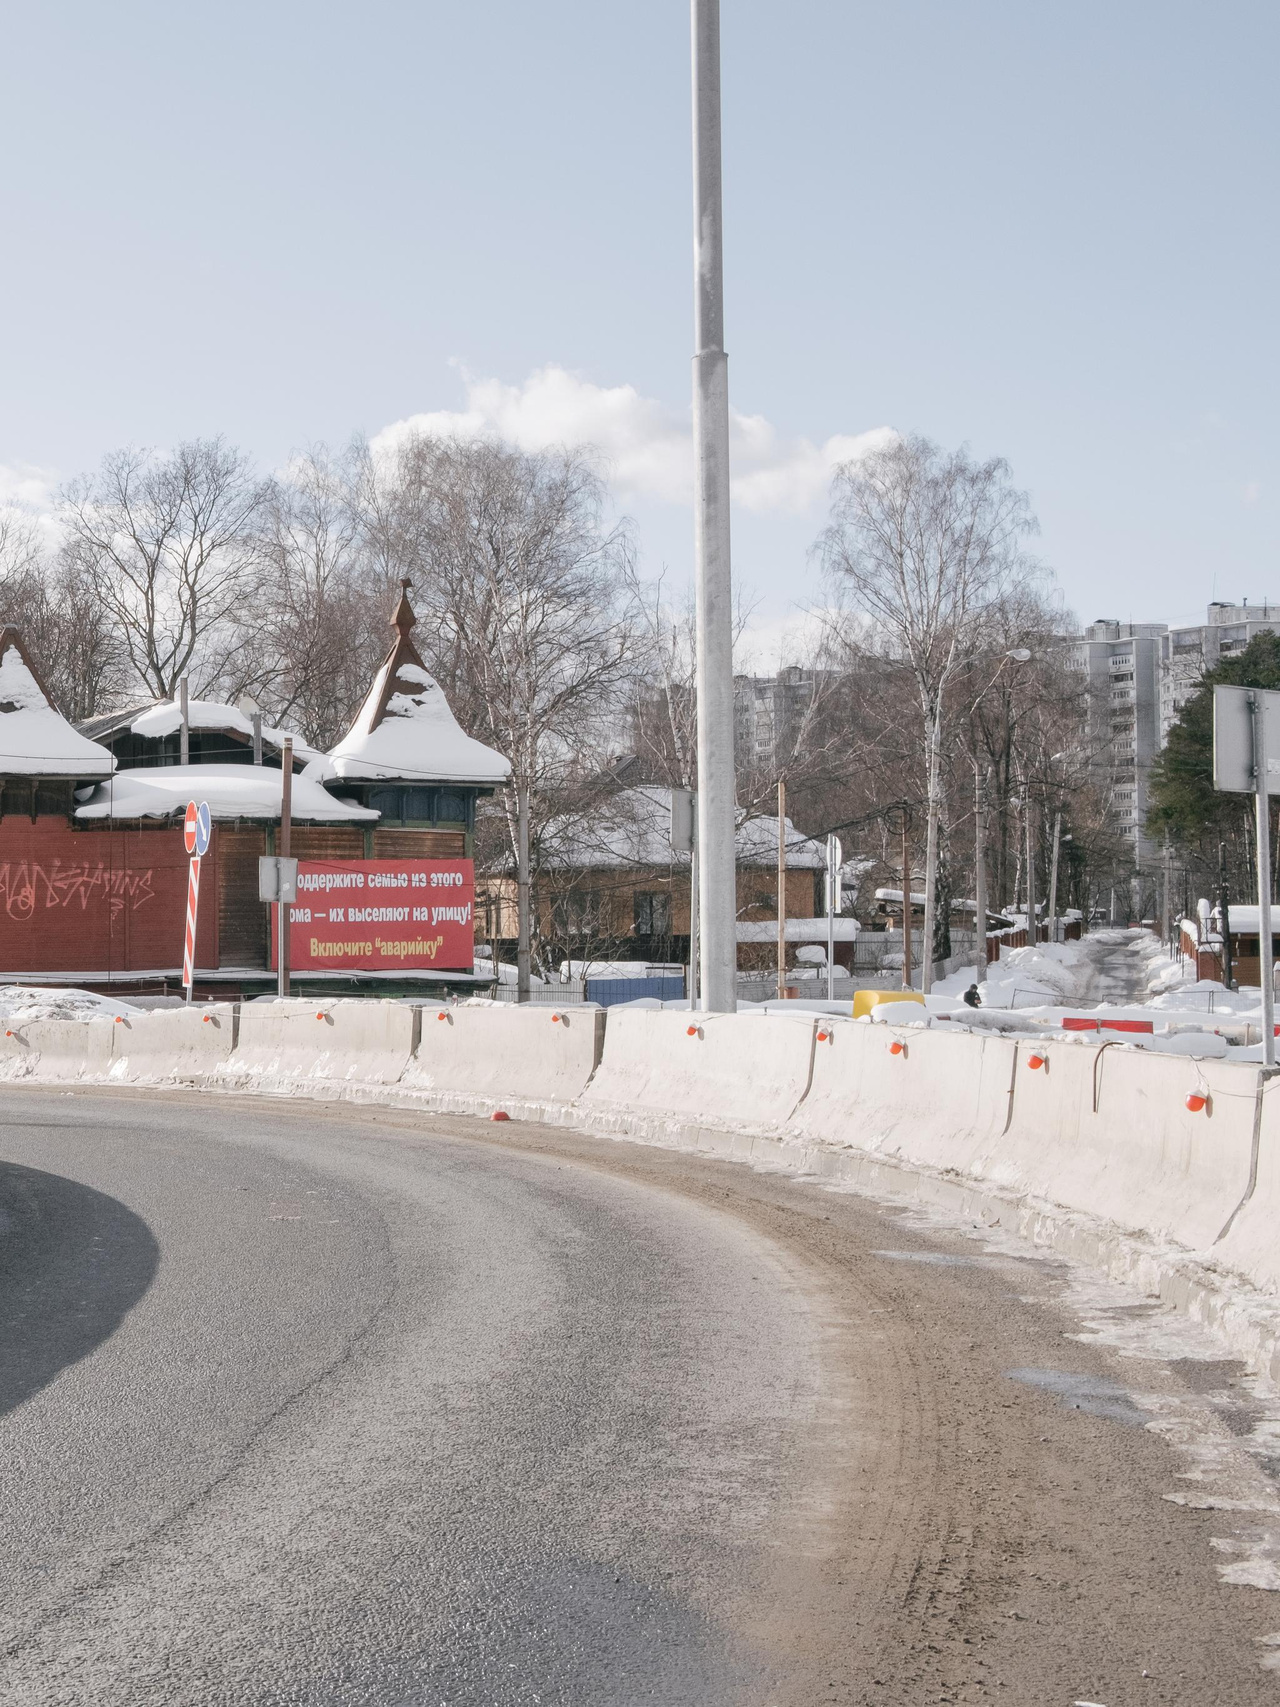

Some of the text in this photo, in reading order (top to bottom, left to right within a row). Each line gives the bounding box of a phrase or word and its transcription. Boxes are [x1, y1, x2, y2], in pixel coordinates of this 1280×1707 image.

[297, 872, 463, 892] оддержите семью из этого
[290, 908, 311, 923] ома
[329, 908, 344, 922] их
[348, 907, 410, 922] выселяют
[413, 907, 428, 921] на
[431, 902, 471, 926] улицу!
[310, 938, 373, 957] Включите
